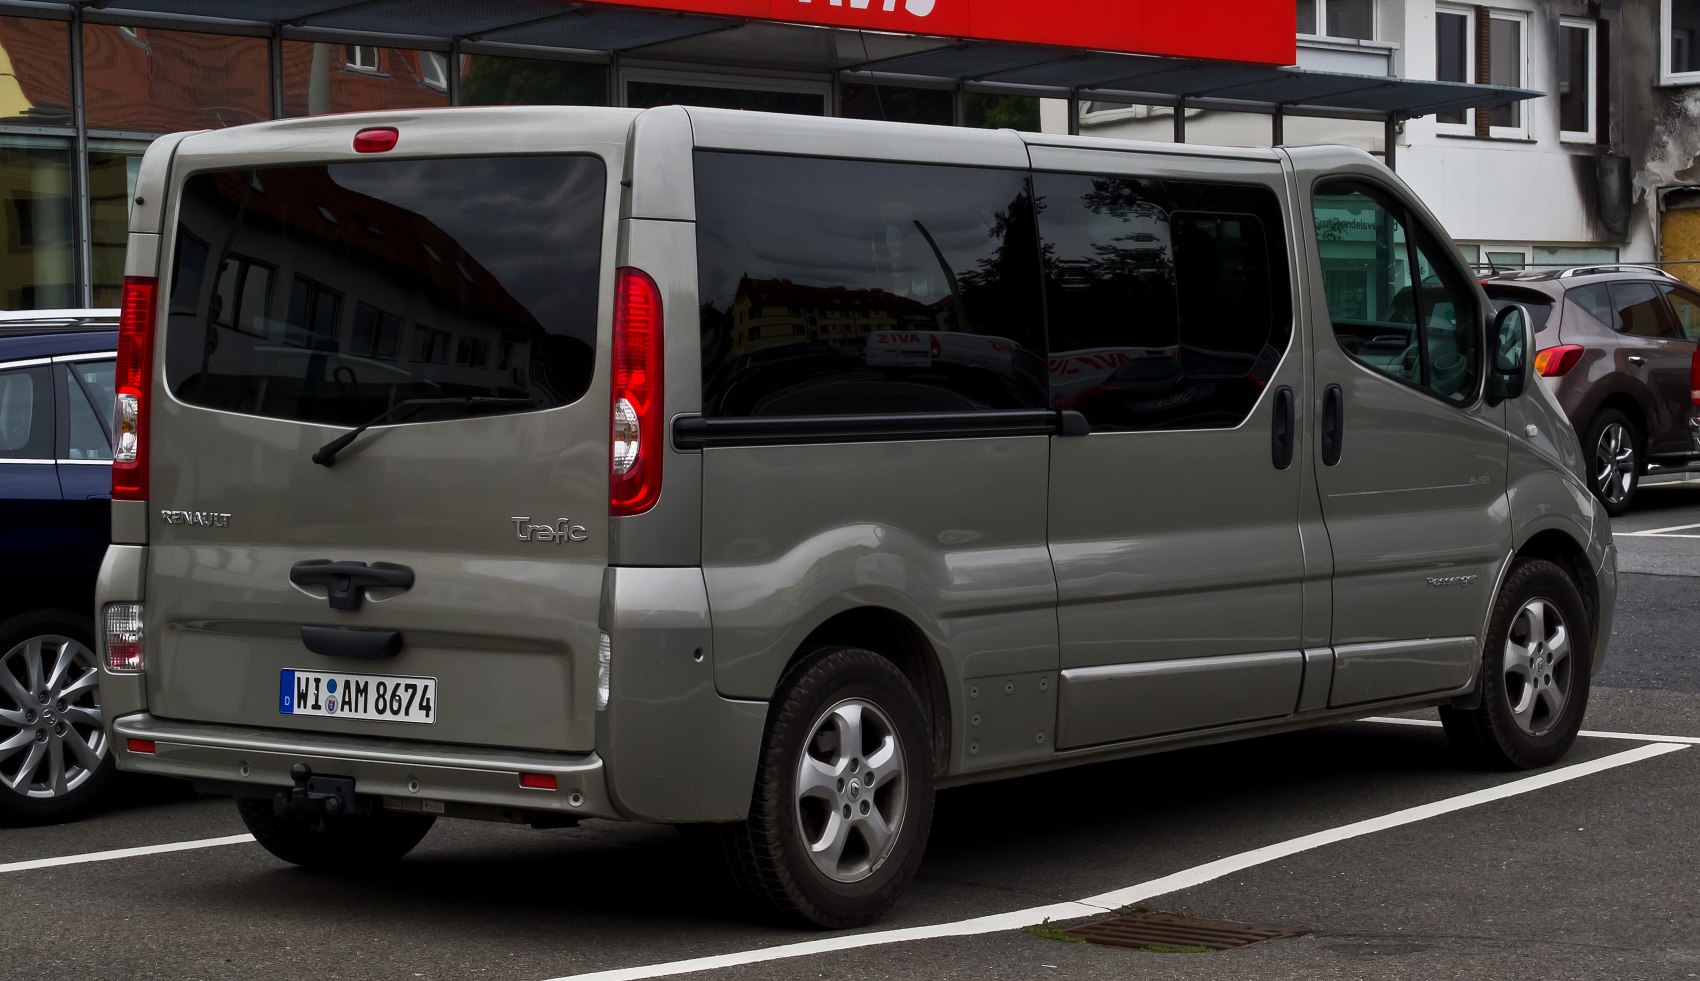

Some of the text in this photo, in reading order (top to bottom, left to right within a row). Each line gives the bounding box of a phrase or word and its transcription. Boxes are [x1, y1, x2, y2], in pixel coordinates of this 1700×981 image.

[161, 509, 232, 528] RENAULT
[510, 516, 588, 544] Trafic
[284, 676, 432, 718] D WI AM 8674
